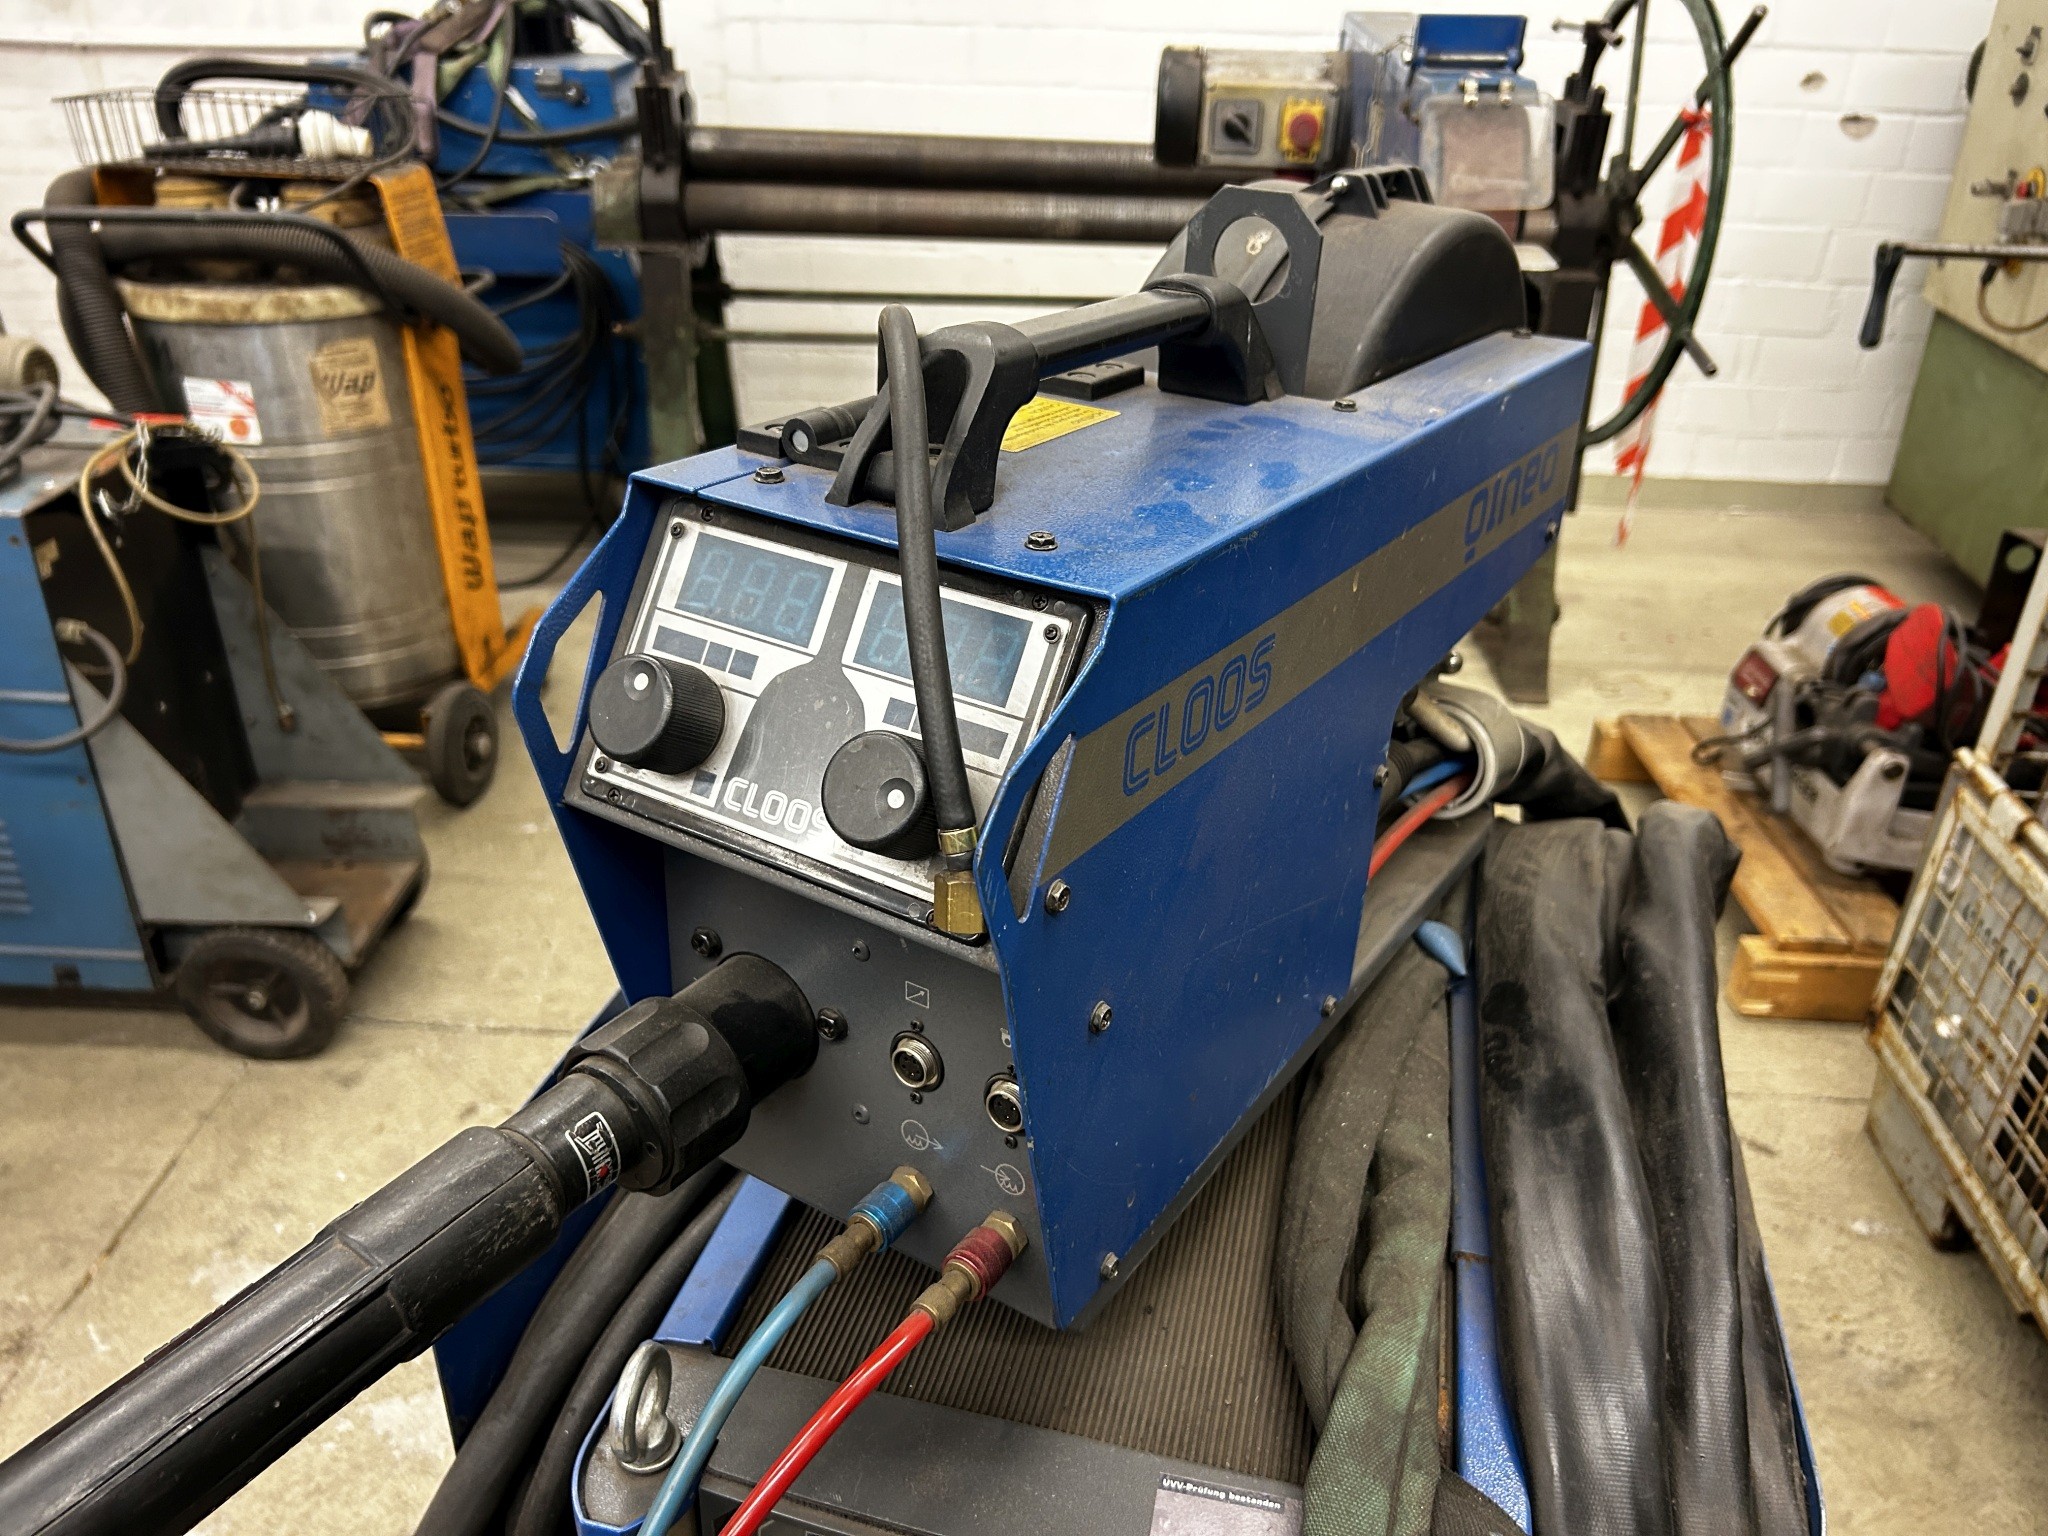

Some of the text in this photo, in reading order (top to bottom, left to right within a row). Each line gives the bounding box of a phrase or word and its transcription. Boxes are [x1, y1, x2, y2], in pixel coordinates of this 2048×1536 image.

[1123, 633, 1276, 797] CLOOS
[1162, 1478, 1281, 1510] UVV-Prüfung bestanden
